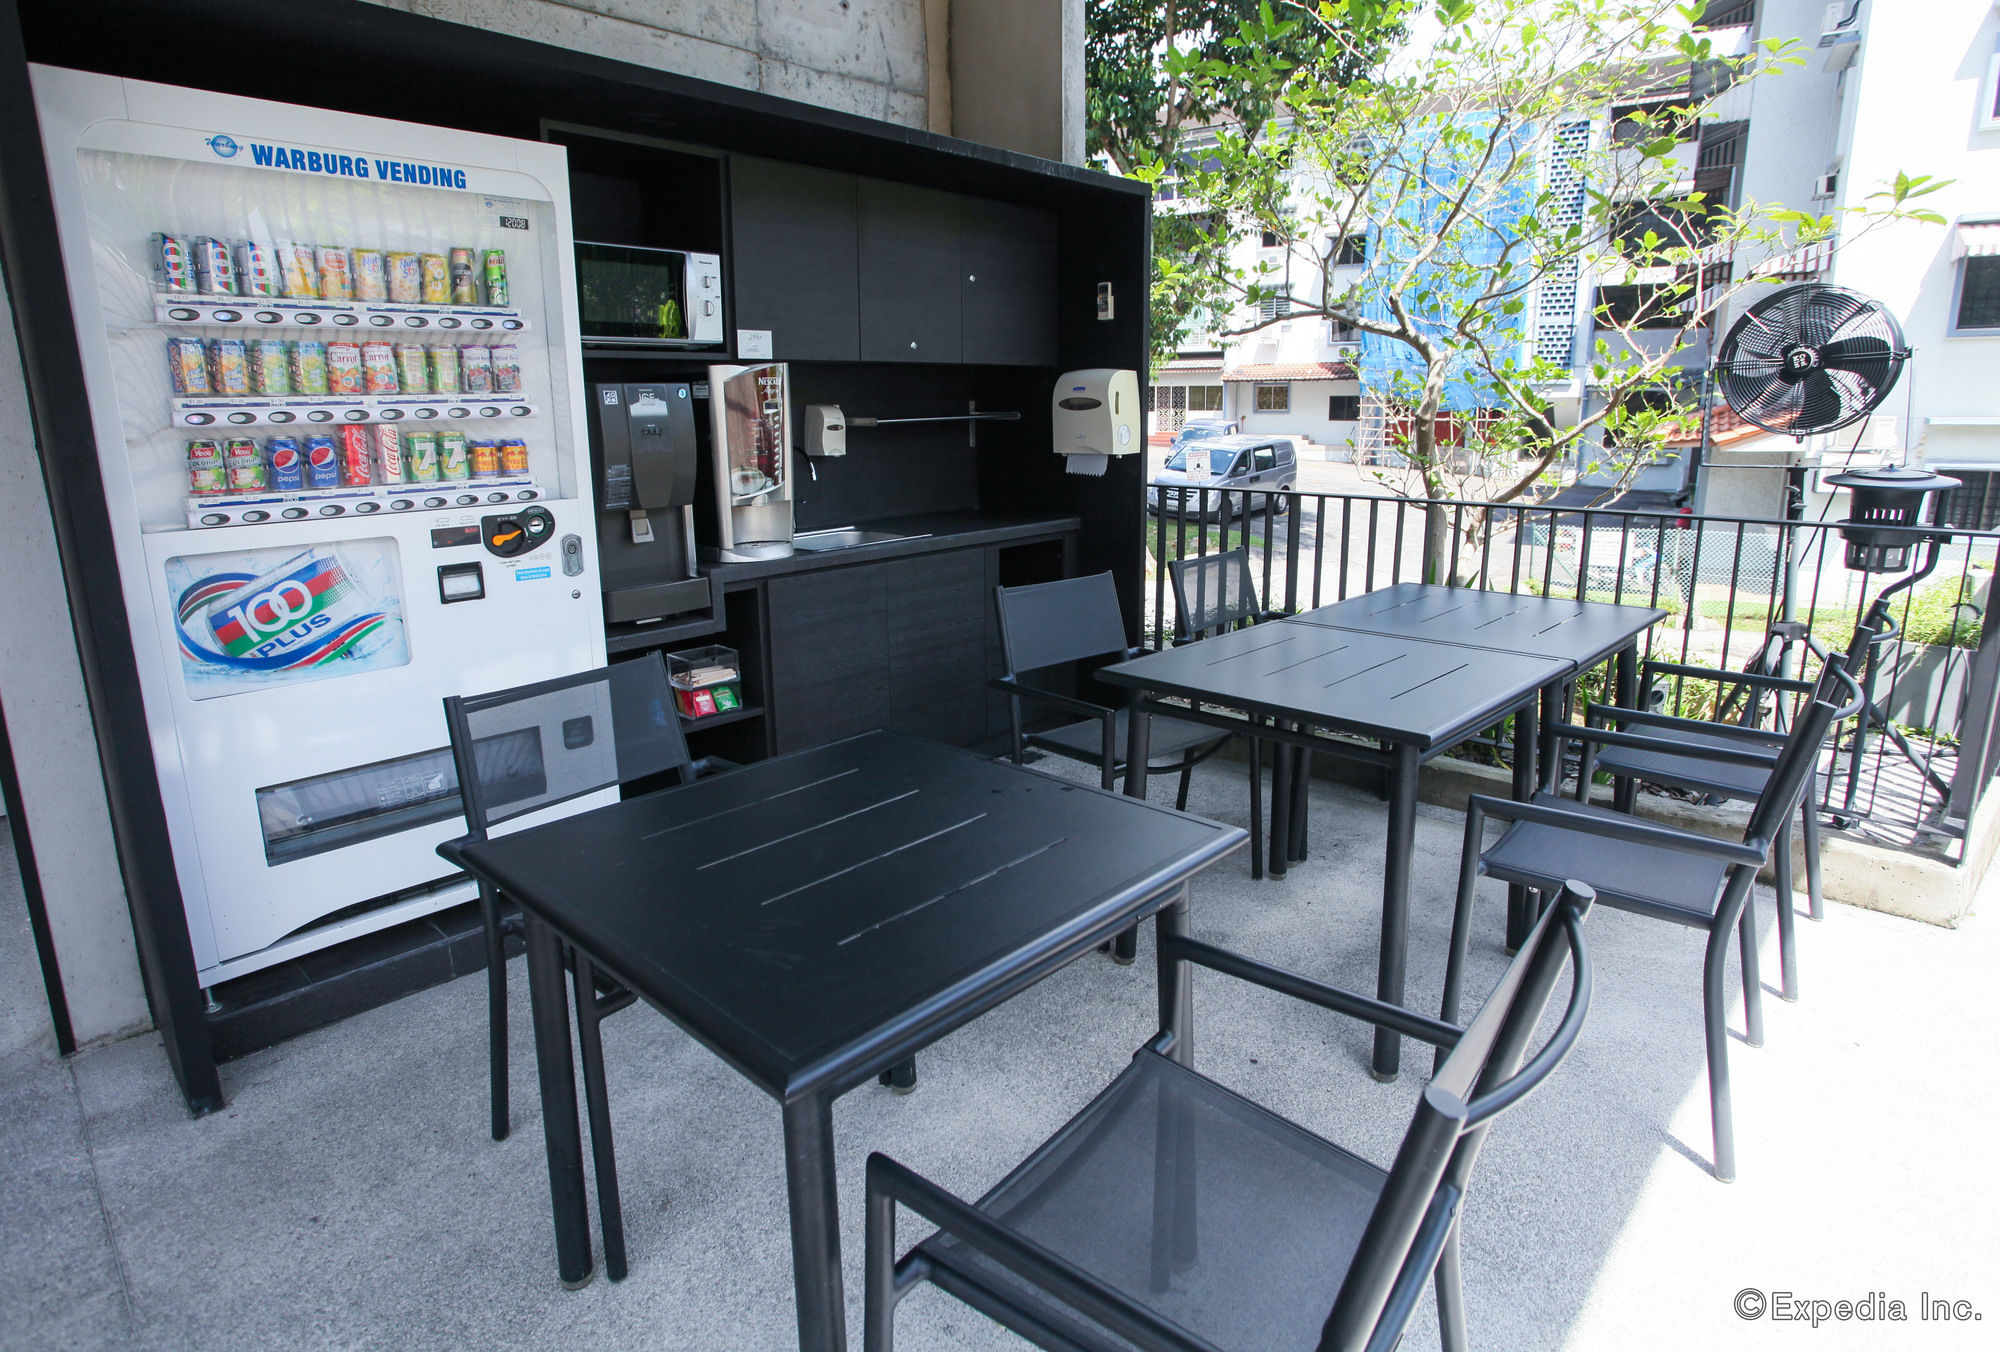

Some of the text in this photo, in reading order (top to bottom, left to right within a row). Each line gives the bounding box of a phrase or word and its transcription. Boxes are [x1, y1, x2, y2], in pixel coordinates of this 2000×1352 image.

[250, 143, 467, 190] WARBURG VENDING
[161, 242, 187, 282] 100
[212, 246, 233, 282] 100
[330, 351, 357, 363] Carrot
[363, 350, 389, 362] Carrot
[277, 474, 300, 483] pepsi
[314, 471, 337, 481] pepsi
[227, 579, 313, 644] 100
[255, 613, 333, 659] PLUS
